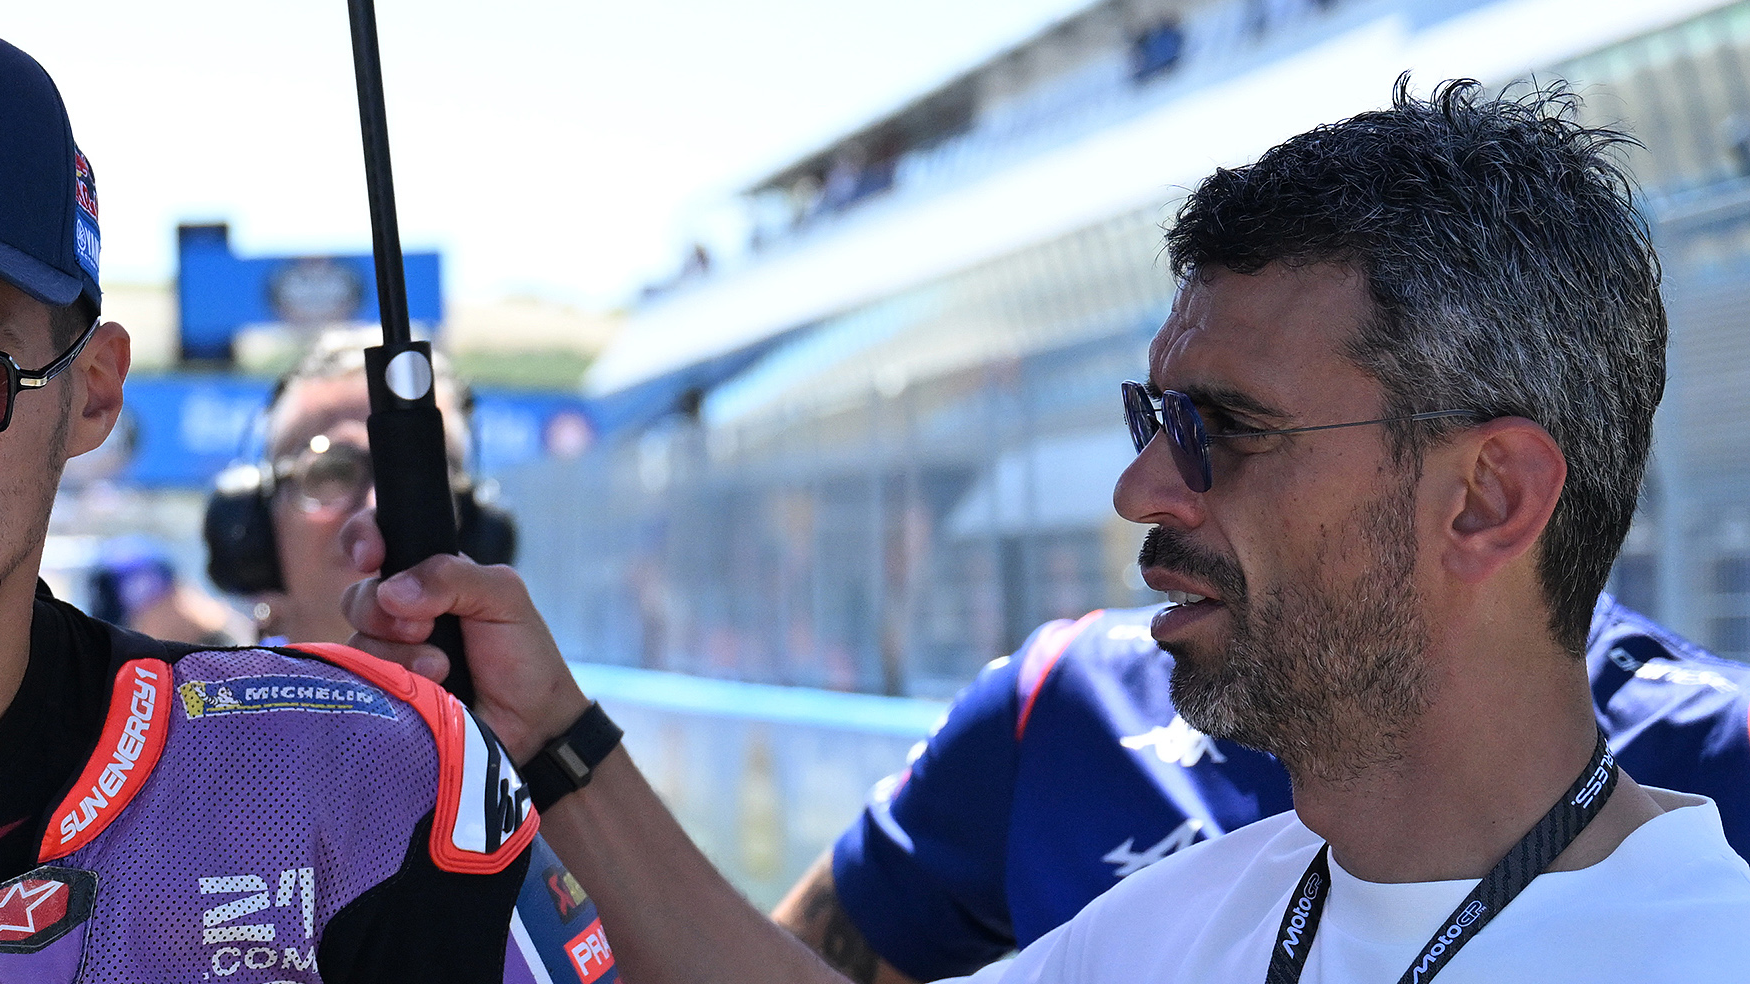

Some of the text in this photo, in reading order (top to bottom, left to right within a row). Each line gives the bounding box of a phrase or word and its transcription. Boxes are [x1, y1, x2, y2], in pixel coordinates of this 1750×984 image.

[245, 686, 374, 704] MICHELIN
[198, 867, 315, 945] 21
[203, 945, 319, 980] .COM
